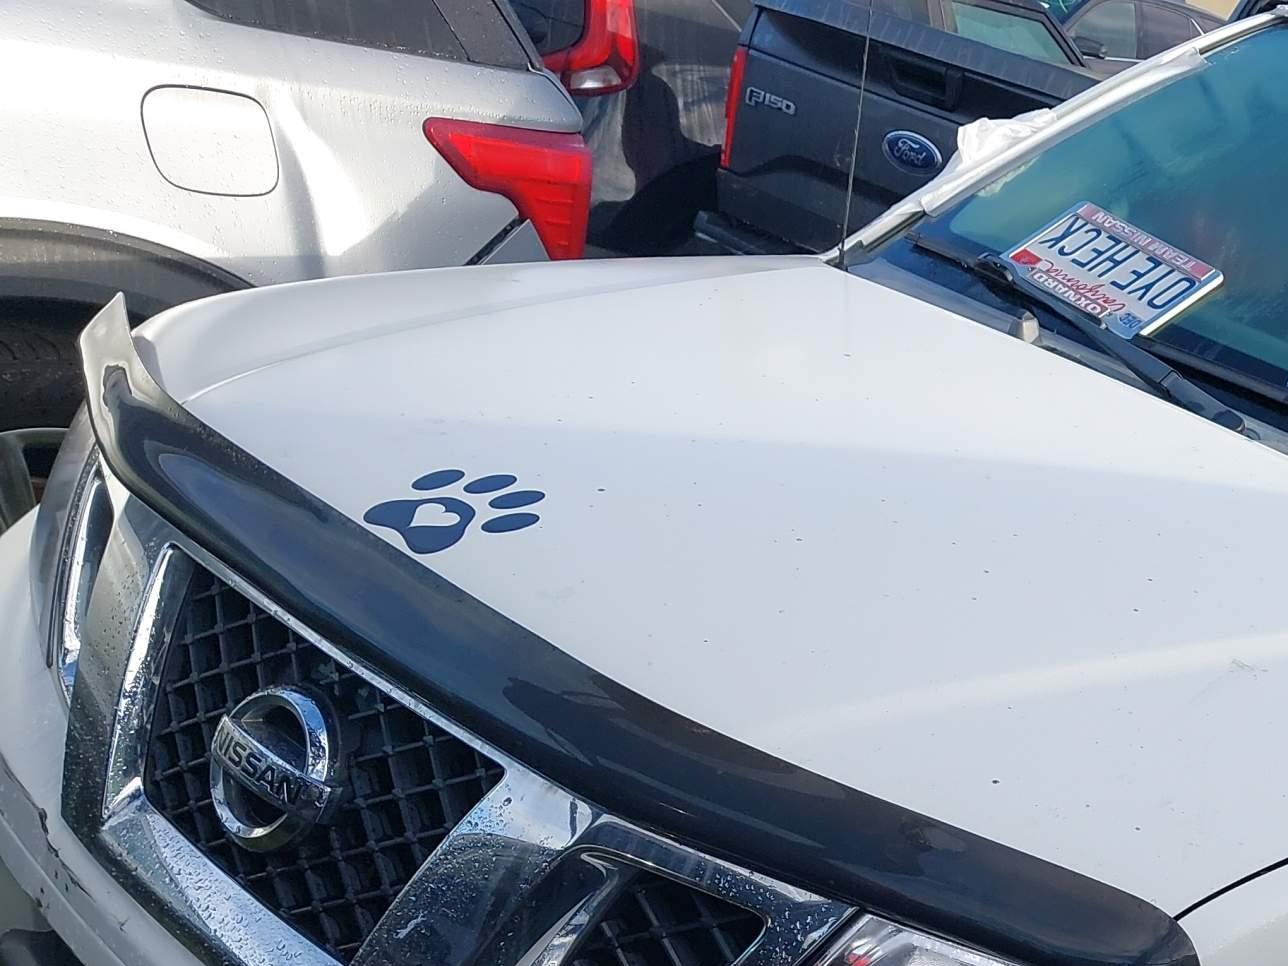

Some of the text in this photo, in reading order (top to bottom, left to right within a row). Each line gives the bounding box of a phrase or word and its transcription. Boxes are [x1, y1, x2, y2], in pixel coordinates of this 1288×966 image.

[745, 86, 797, 115] F150
[893, 137, 928, 166] Ford
[1093, 211, 1197, 269] TEAM NISSAN
[1033, 270, 1104, 316] OXNARD
[1119, 312, 1142, 329] DEC
[216, 727, 301, 804] NISSAN
